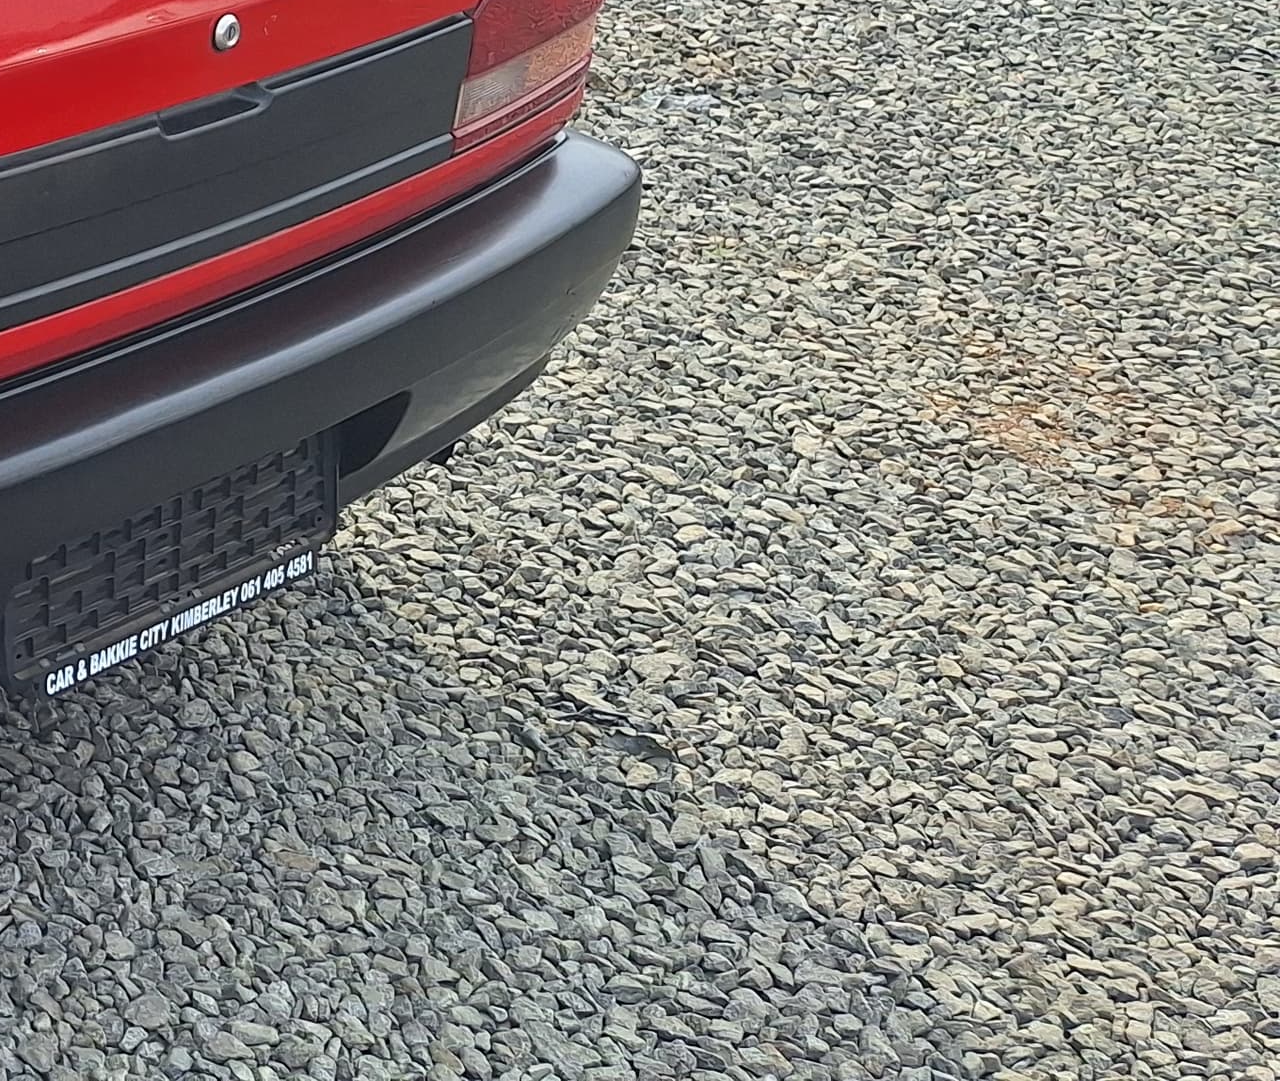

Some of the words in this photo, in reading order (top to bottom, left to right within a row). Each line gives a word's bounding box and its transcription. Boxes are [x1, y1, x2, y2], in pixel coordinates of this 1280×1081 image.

[46, 665, 75, 695] CAR
[77, 659, 88, 681] &
[90, 634, 138, 676] BAKKIE
[140, 620, 169, 650] CITY
[171, 586, 240, 636] KIMBERLEY
[241, 575, 261, 602] 061
[263, 564, 285, 590] 405
[287, 550, 313, 579] 4581
